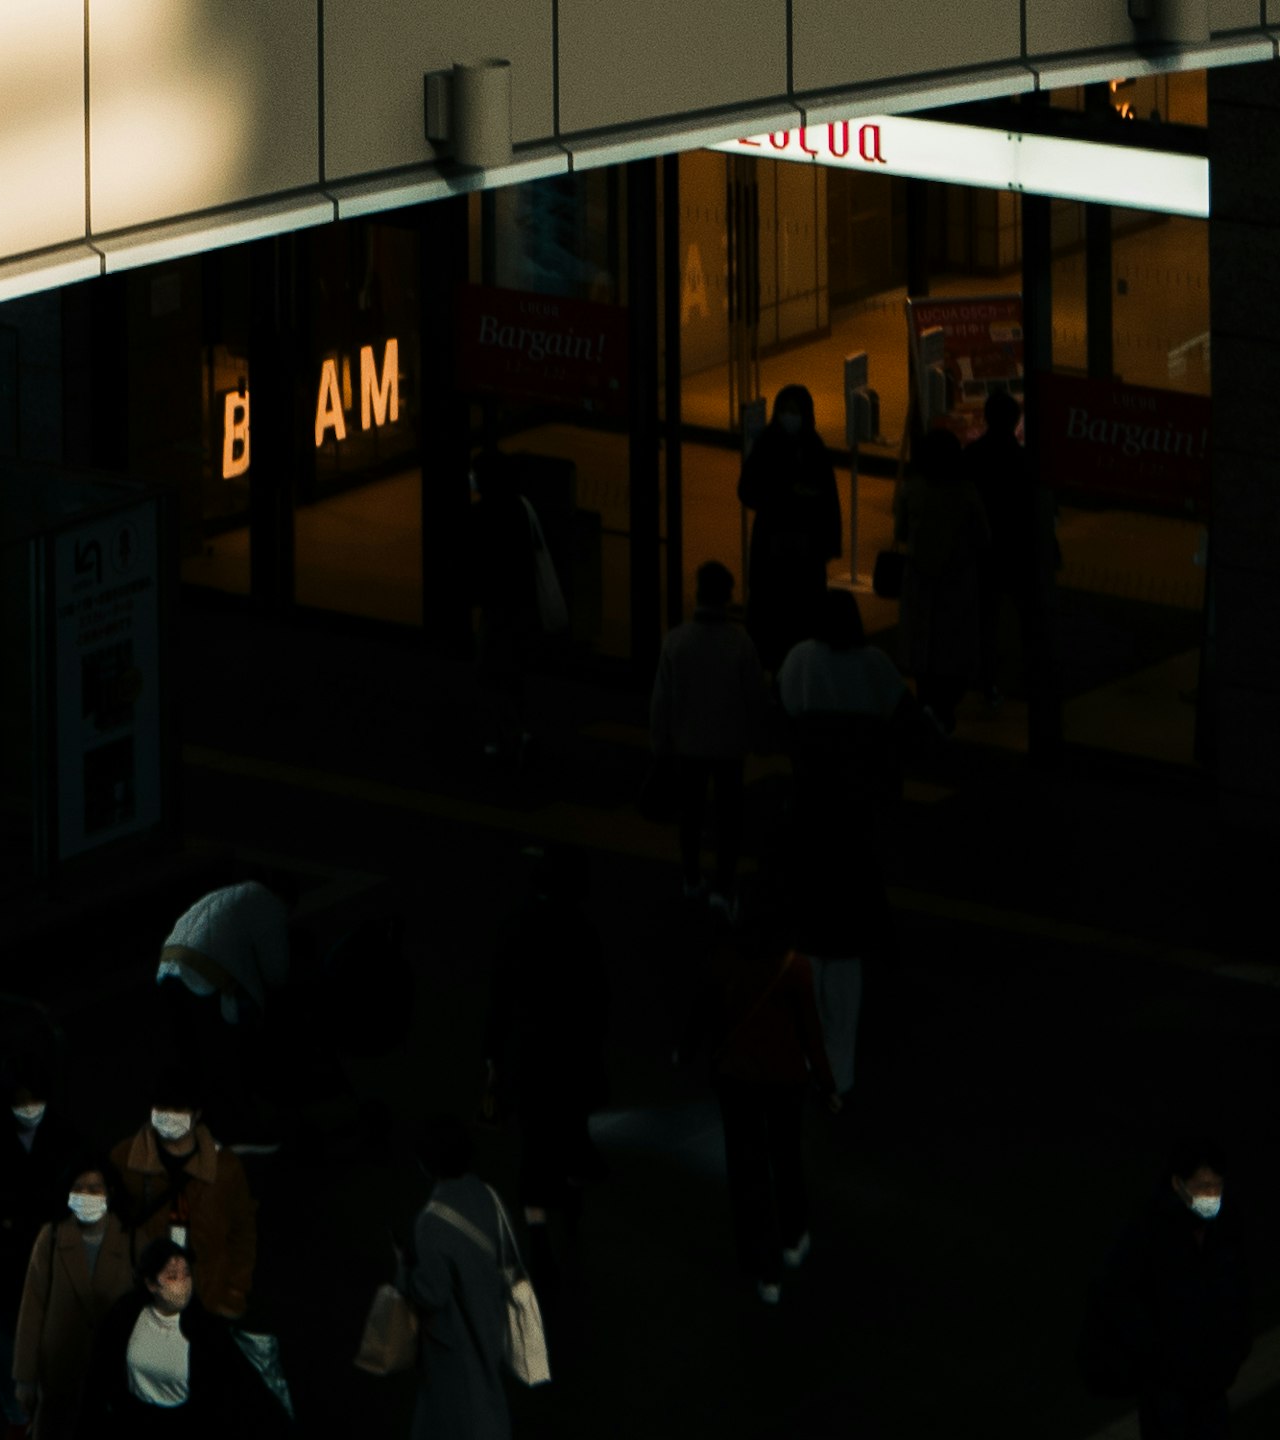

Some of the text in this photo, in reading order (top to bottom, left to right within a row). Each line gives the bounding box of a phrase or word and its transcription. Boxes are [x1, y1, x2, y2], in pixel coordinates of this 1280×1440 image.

[478, 313, 608, 364] Bargain!
[222, 337, 400, 480] BAM
[1065, 404, 1209, 460] Bargain!
